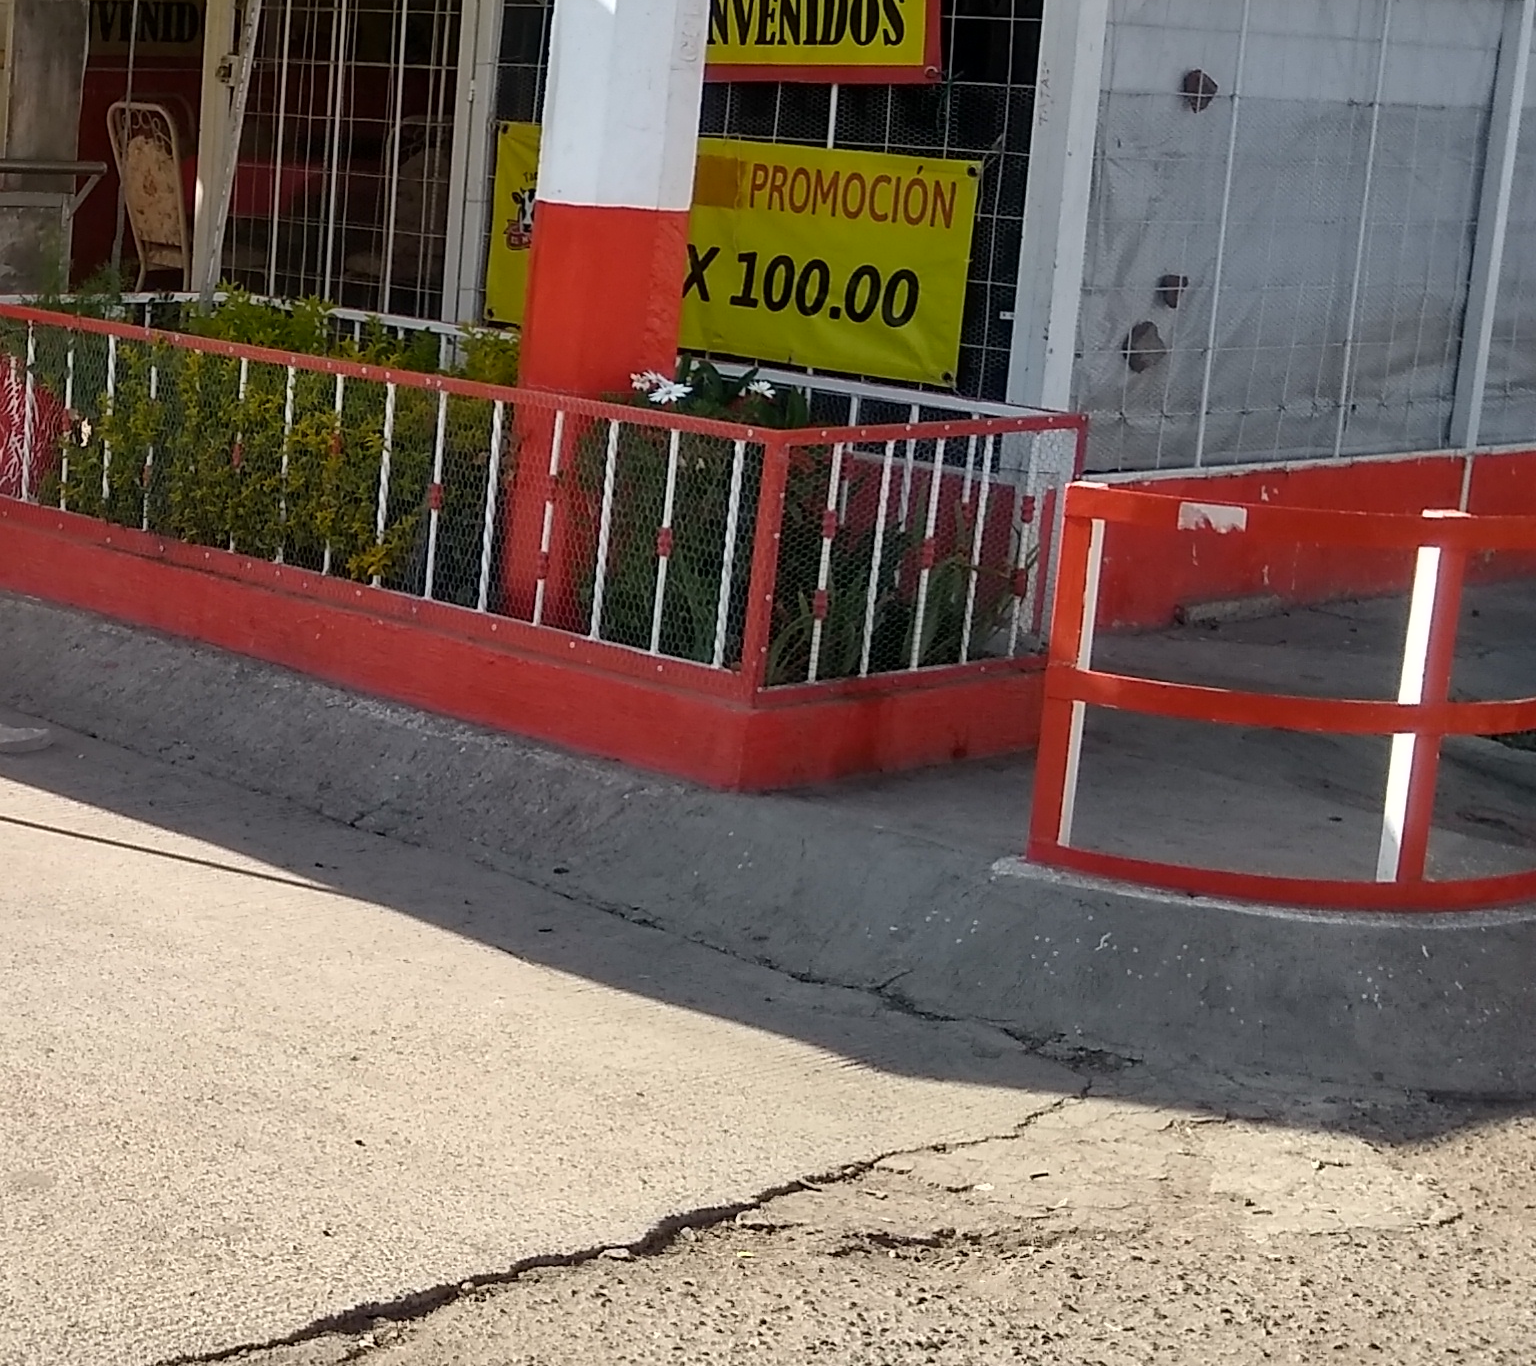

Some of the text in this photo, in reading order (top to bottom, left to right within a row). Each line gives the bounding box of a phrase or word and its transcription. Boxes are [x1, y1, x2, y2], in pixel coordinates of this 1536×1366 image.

[90, 0, 201, 44] VENID
[749, 163, 957, 228] PROMOCIÓN
[682, 243, 920, 328] X 100.00
